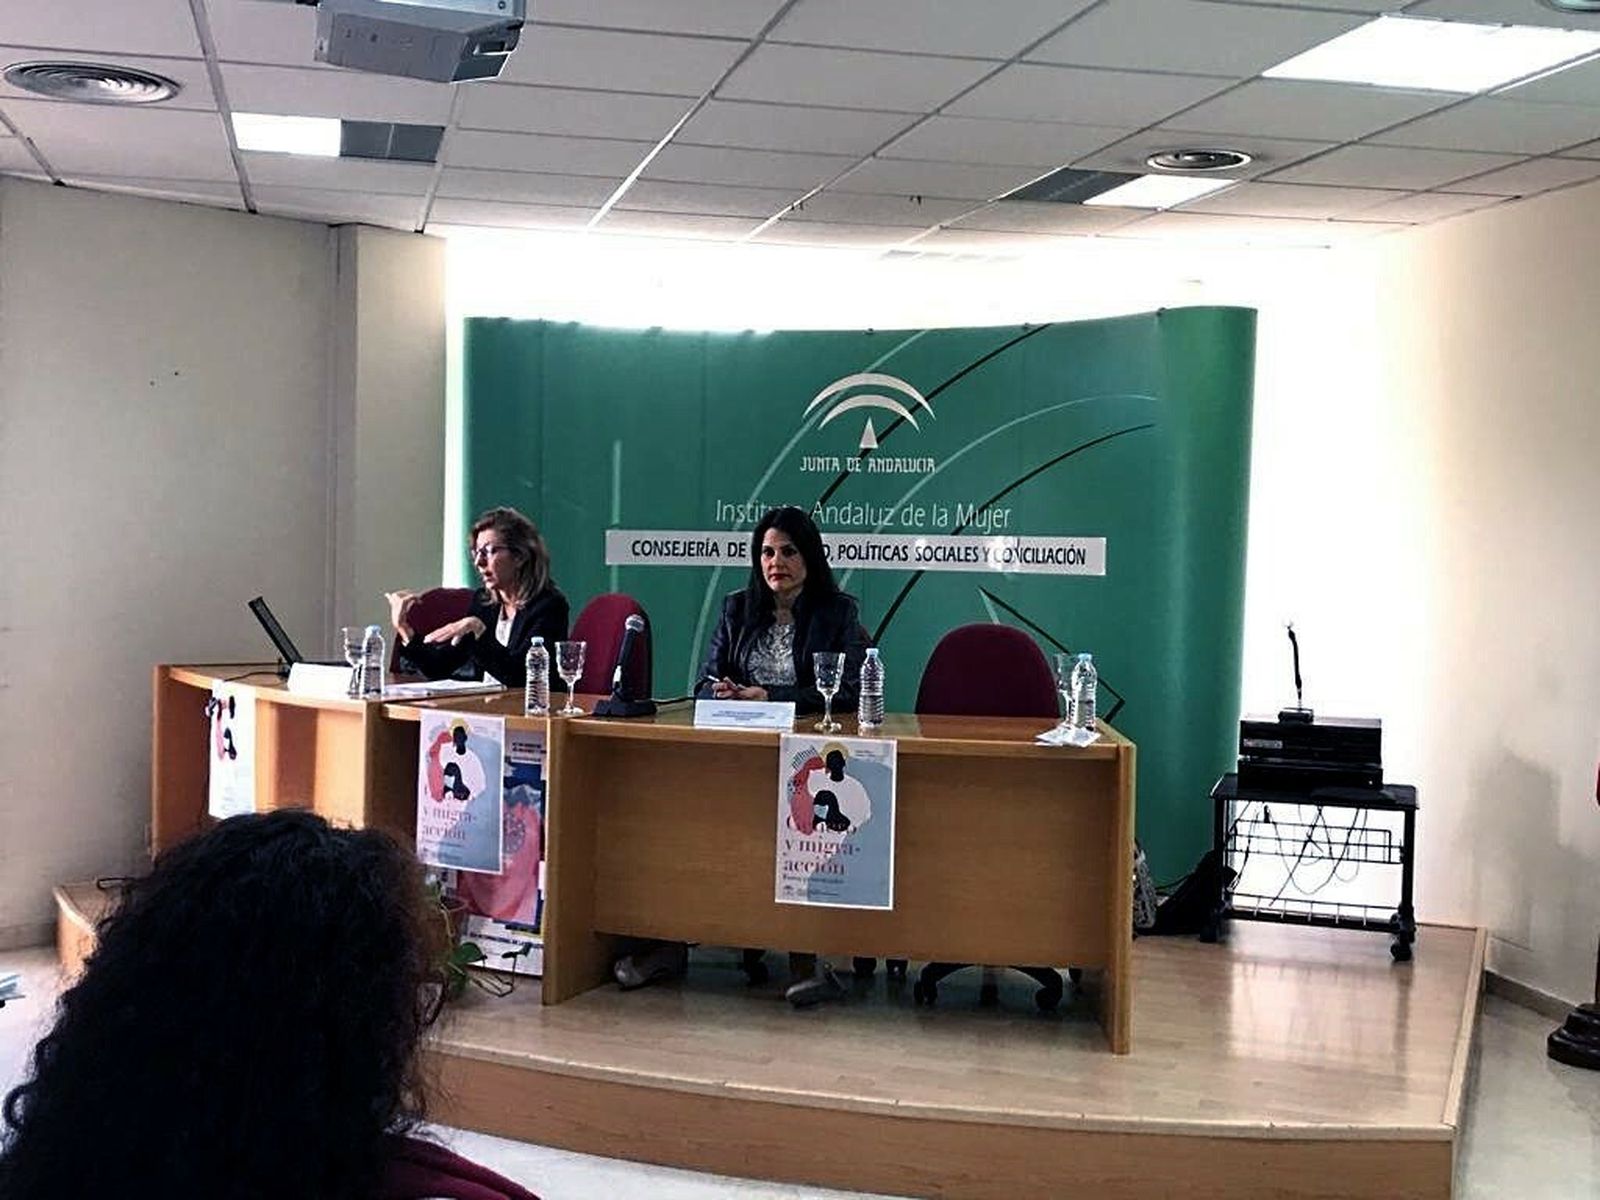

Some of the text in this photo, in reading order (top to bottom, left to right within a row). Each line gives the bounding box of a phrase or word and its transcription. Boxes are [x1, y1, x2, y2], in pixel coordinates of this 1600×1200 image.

[799, 456, 841, 472] JUNTA
[847, 457, 862, 473] DE
[715, 499, 1012, 535] Instit Andaluz de la Mujer
[631, 537, 720, 558] CONSEJERÍA
[727, 542, 747, 559] DE
[838, 541, 909, 562] POLÍTICAS
[915, 545, 979, 563] SOCIALES
[983, 546, 990, 563] Y
[994, 543, 1086, 566] CONCILIACIÓN
[782, 855, 846, 876] acción
